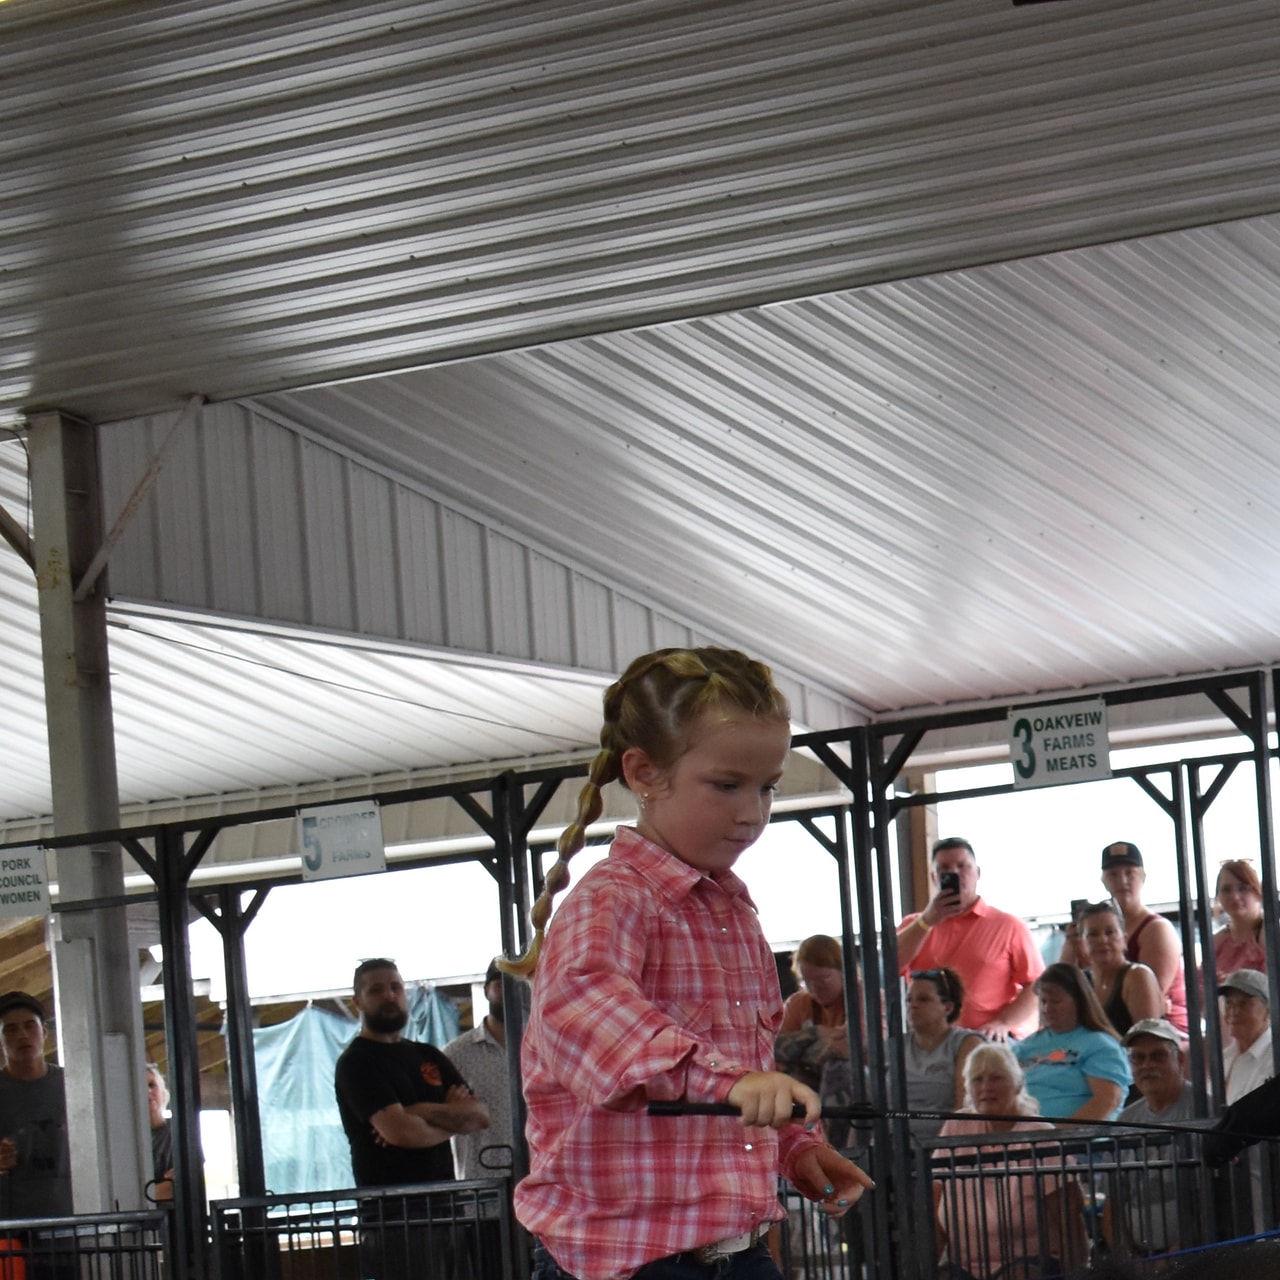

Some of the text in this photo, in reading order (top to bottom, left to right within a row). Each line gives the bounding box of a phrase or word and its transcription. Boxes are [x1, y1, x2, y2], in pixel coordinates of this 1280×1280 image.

[1033, 711, 1103, 732] OAKVEIW
[1013, 718, 1036, 779] 3
[1043, 732, 1096, 752] FARMS
[1046, 753, 1097, 773] MEATS
[303, 817, 322, 872] 5
[1, 857, 32, 872] PORK
[0, 890, 41, 904] WOMEN
